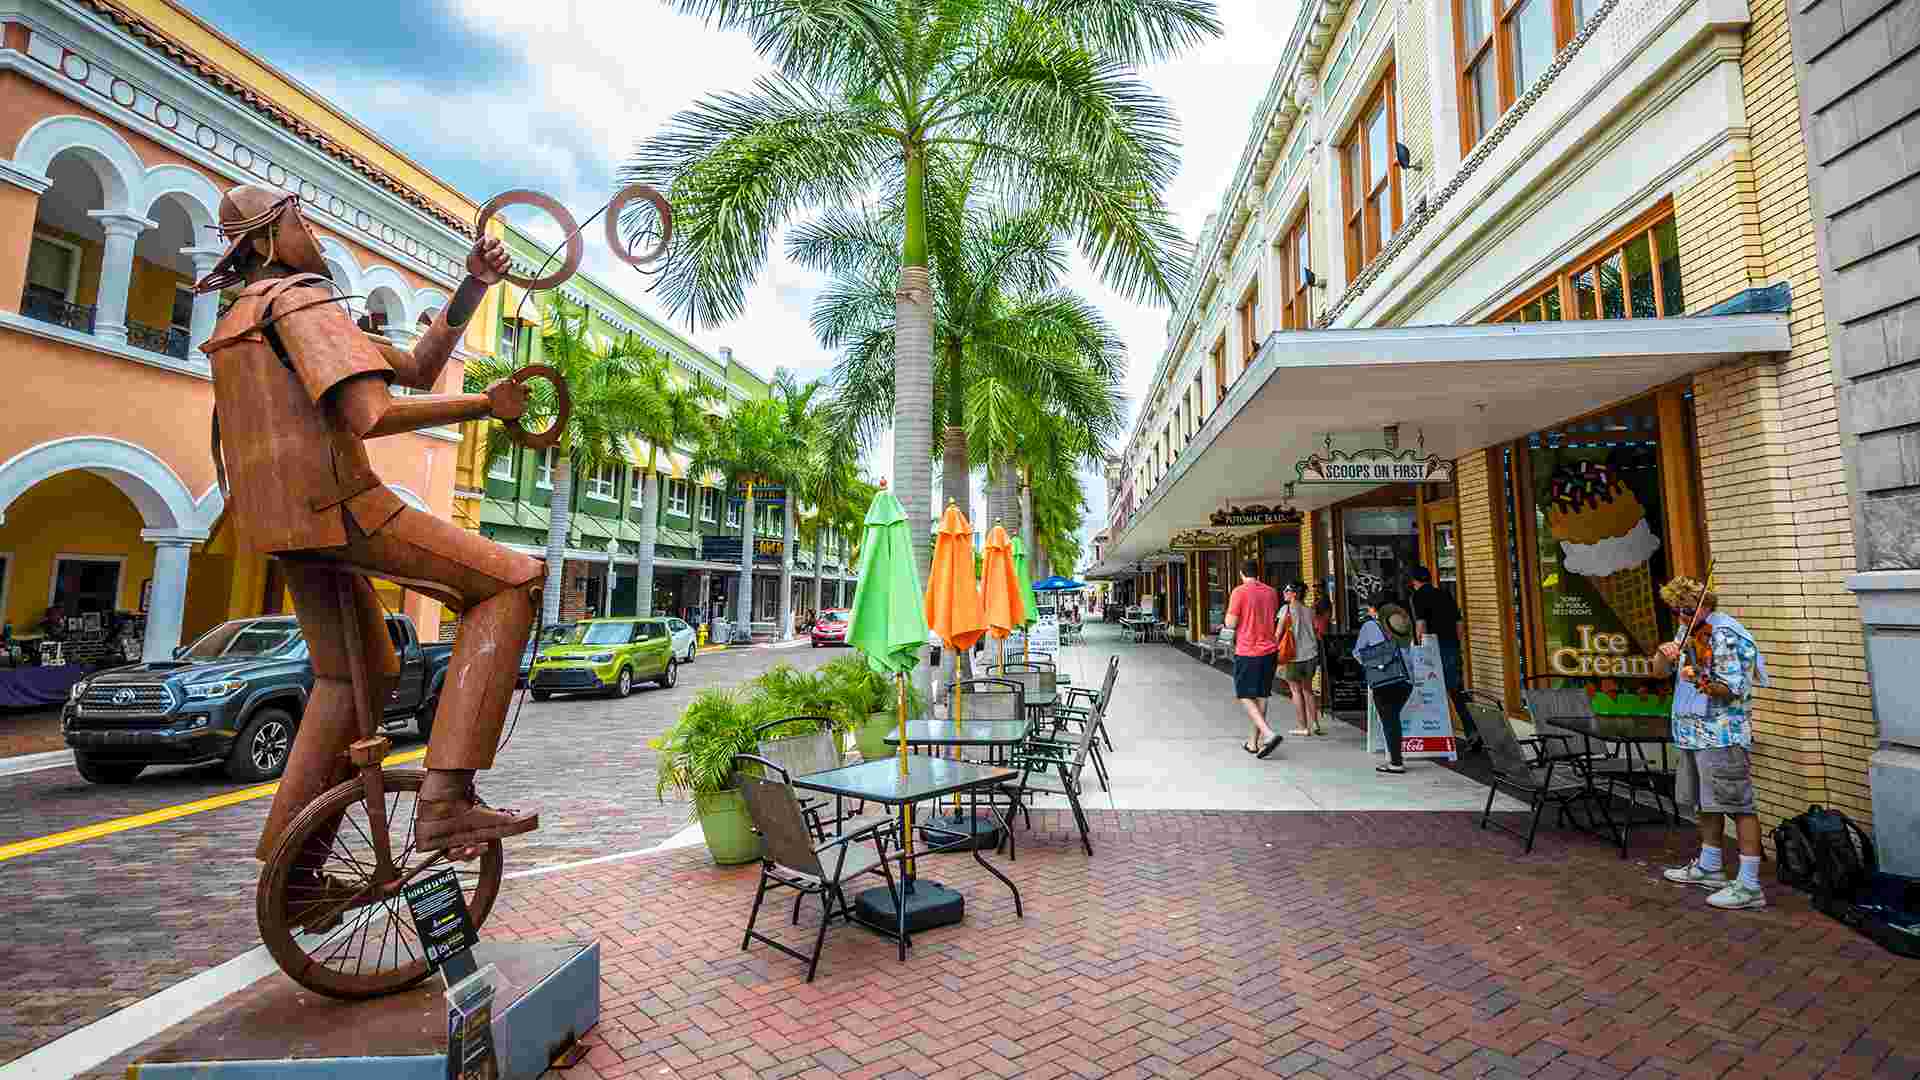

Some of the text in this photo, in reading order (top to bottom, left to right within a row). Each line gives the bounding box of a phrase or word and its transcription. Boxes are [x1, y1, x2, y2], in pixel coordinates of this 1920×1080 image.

[1326, 464, 1424, 479] SCOOPS ON FIRST
[1576, 625, 1627, 654] Ice
[1552, 647, 1657, 674] Cream
